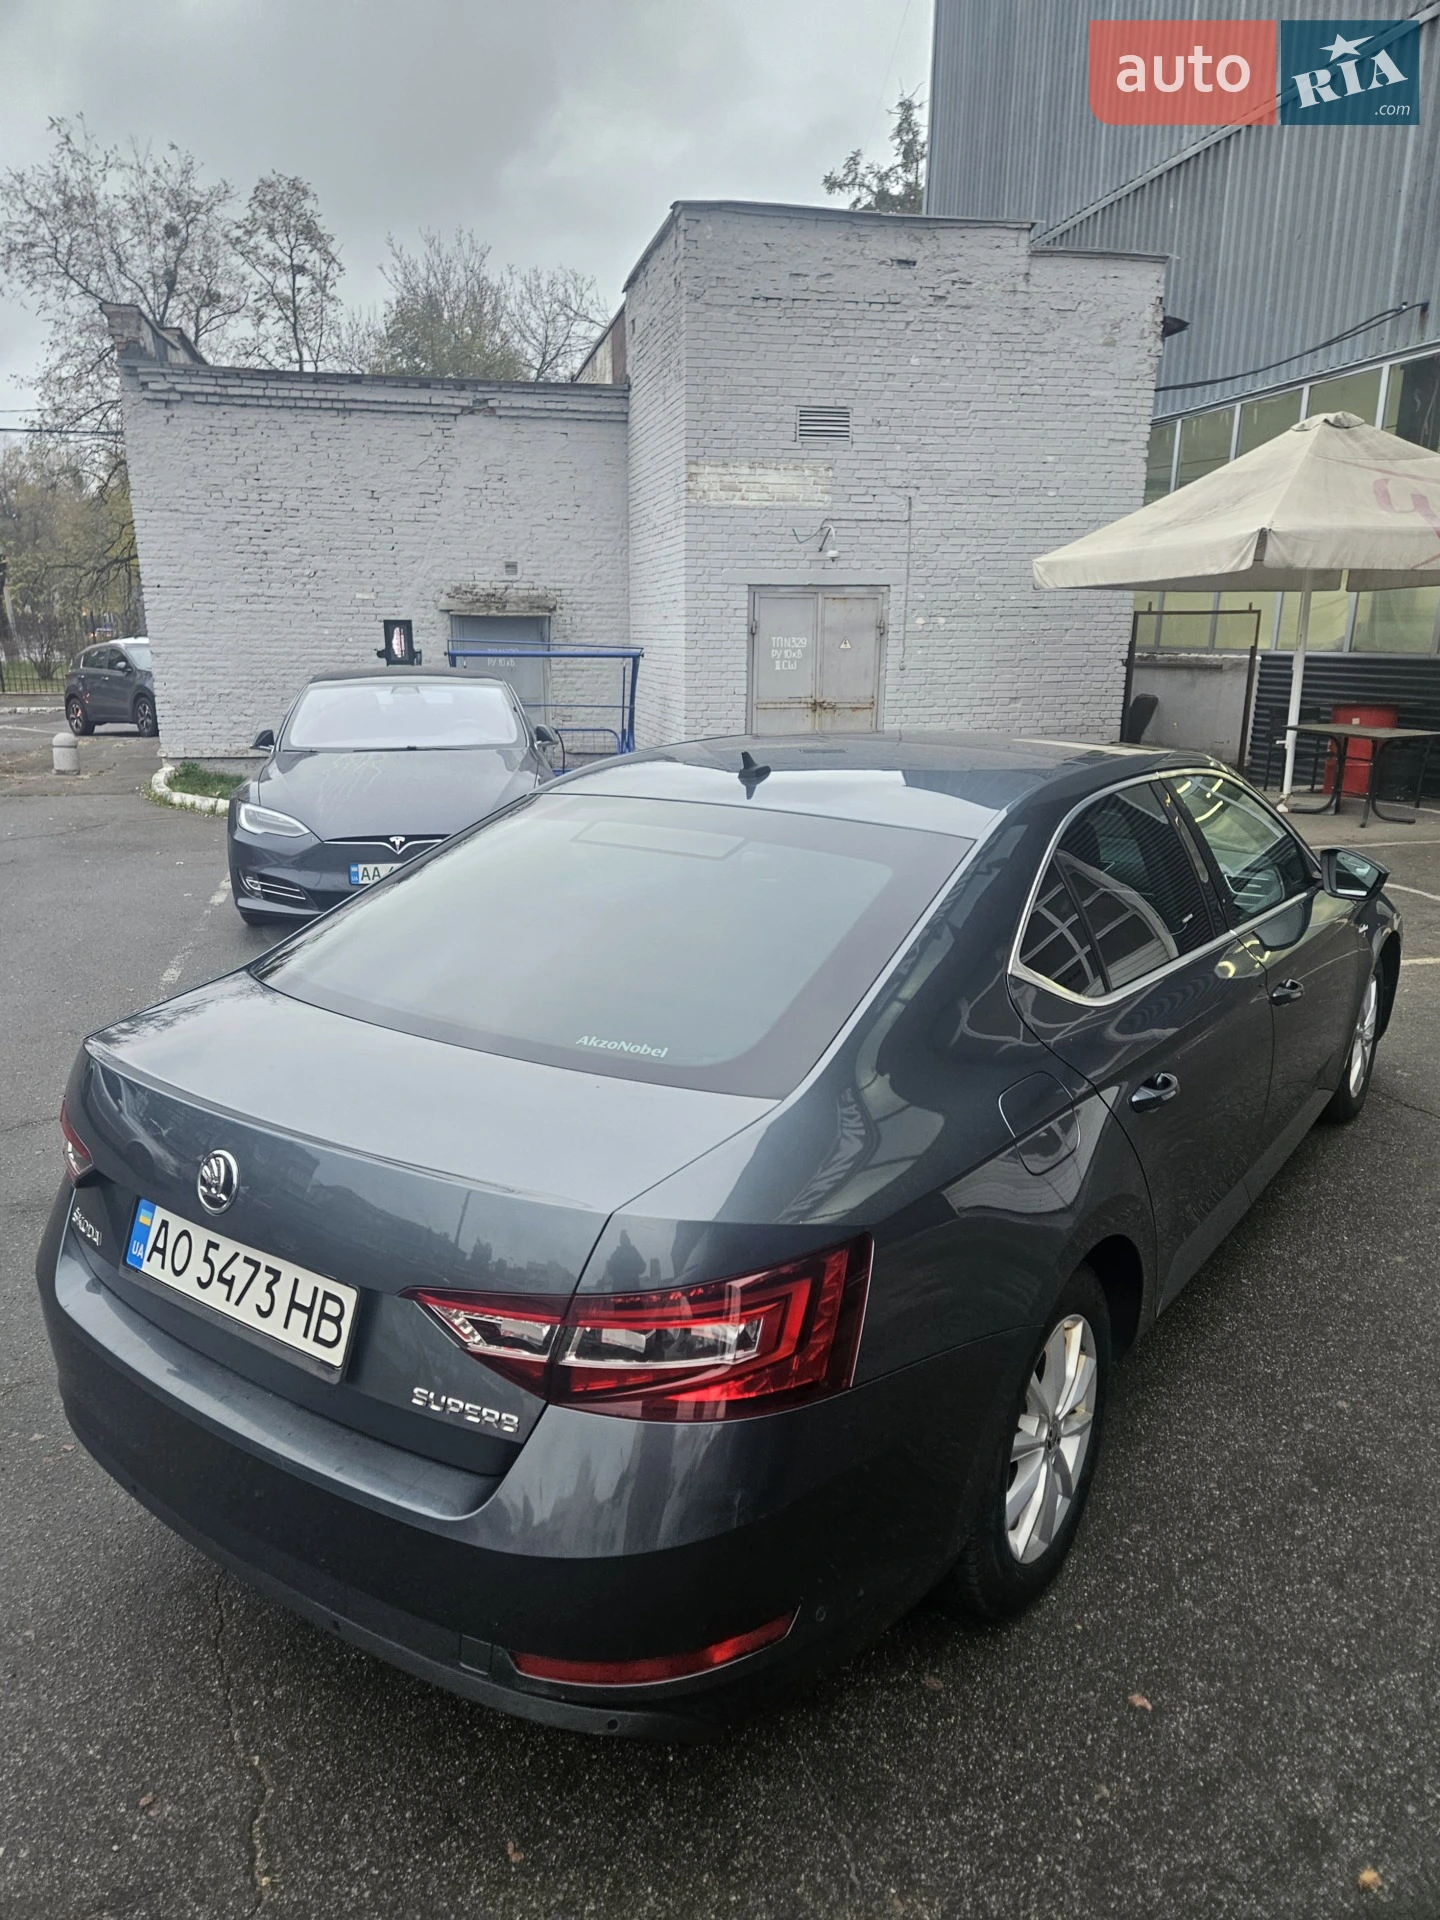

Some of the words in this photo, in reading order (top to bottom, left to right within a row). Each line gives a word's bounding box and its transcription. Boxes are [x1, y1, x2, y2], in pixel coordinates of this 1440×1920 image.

[576, 1035, 668, 1058] AkzoNobel
[131, 1240, 145, 1259] UA
[146, 1218, 193, 1278] AO
[196, 1239, 282, 1319] 5473
[283, 1277, 346, 1349] HB
[411, 1386, 519, 1433] SUPERB
